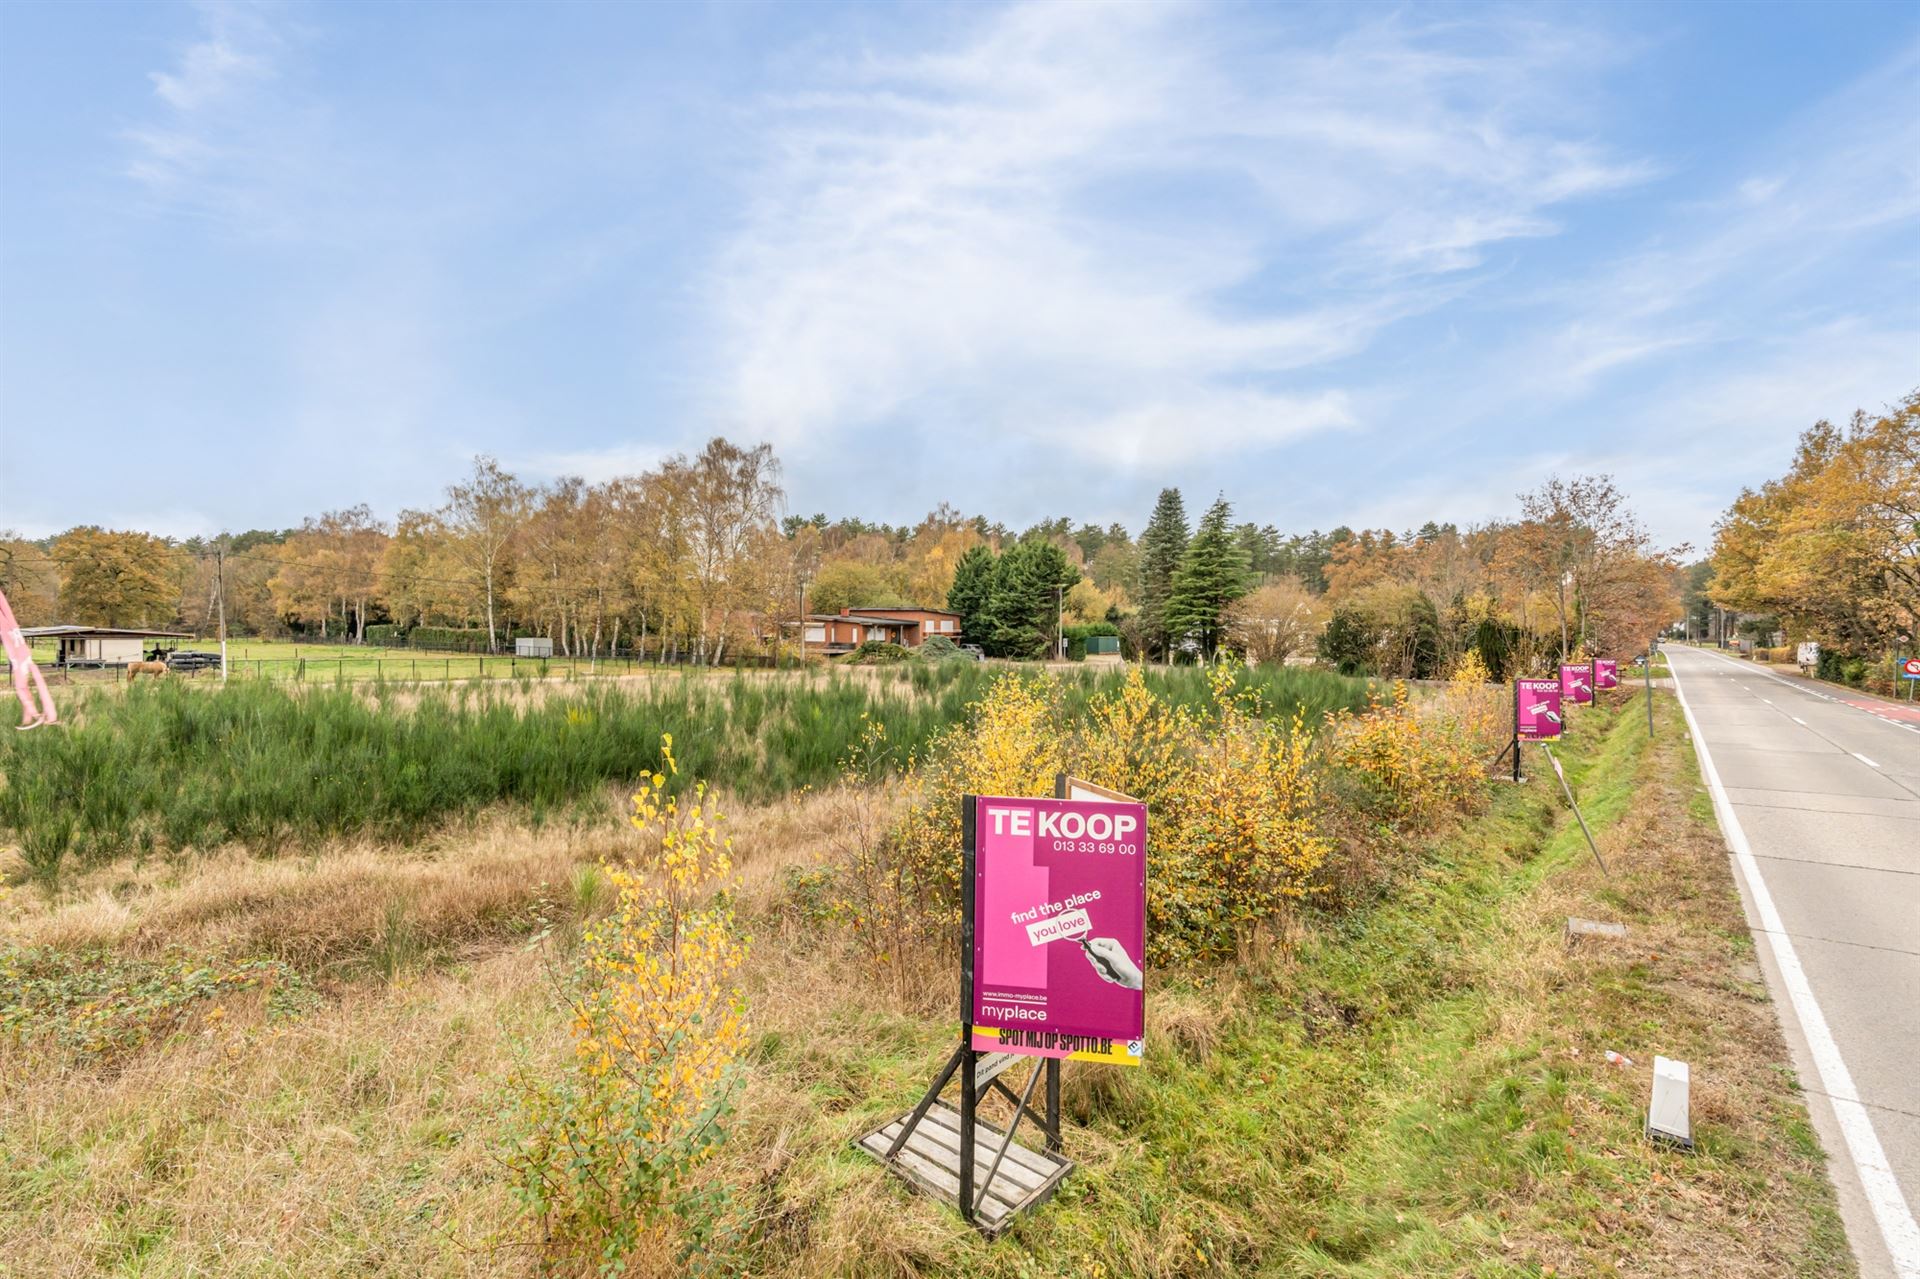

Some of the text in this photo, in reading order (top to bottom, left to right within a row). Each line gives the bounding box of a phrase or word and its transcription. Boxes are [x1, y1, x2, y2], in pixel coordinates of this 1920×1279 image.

[1520, 682, 1559, 690] TE KOOP
[988, 808, 1137, 841] TE KOOP
[1053, 840, 1137, 855] 013 33 69 00
[1011, 890, 1102, 924] find the place
[1033, 917, 1086, 941] you love
[982, 991, 1048, 1001] www.immo-myplace.be
[982, 1005, 1047, 1021] myplace
[999, 1028, 1113, 1055] SPOT MIJ OP SPOTTO.BE
